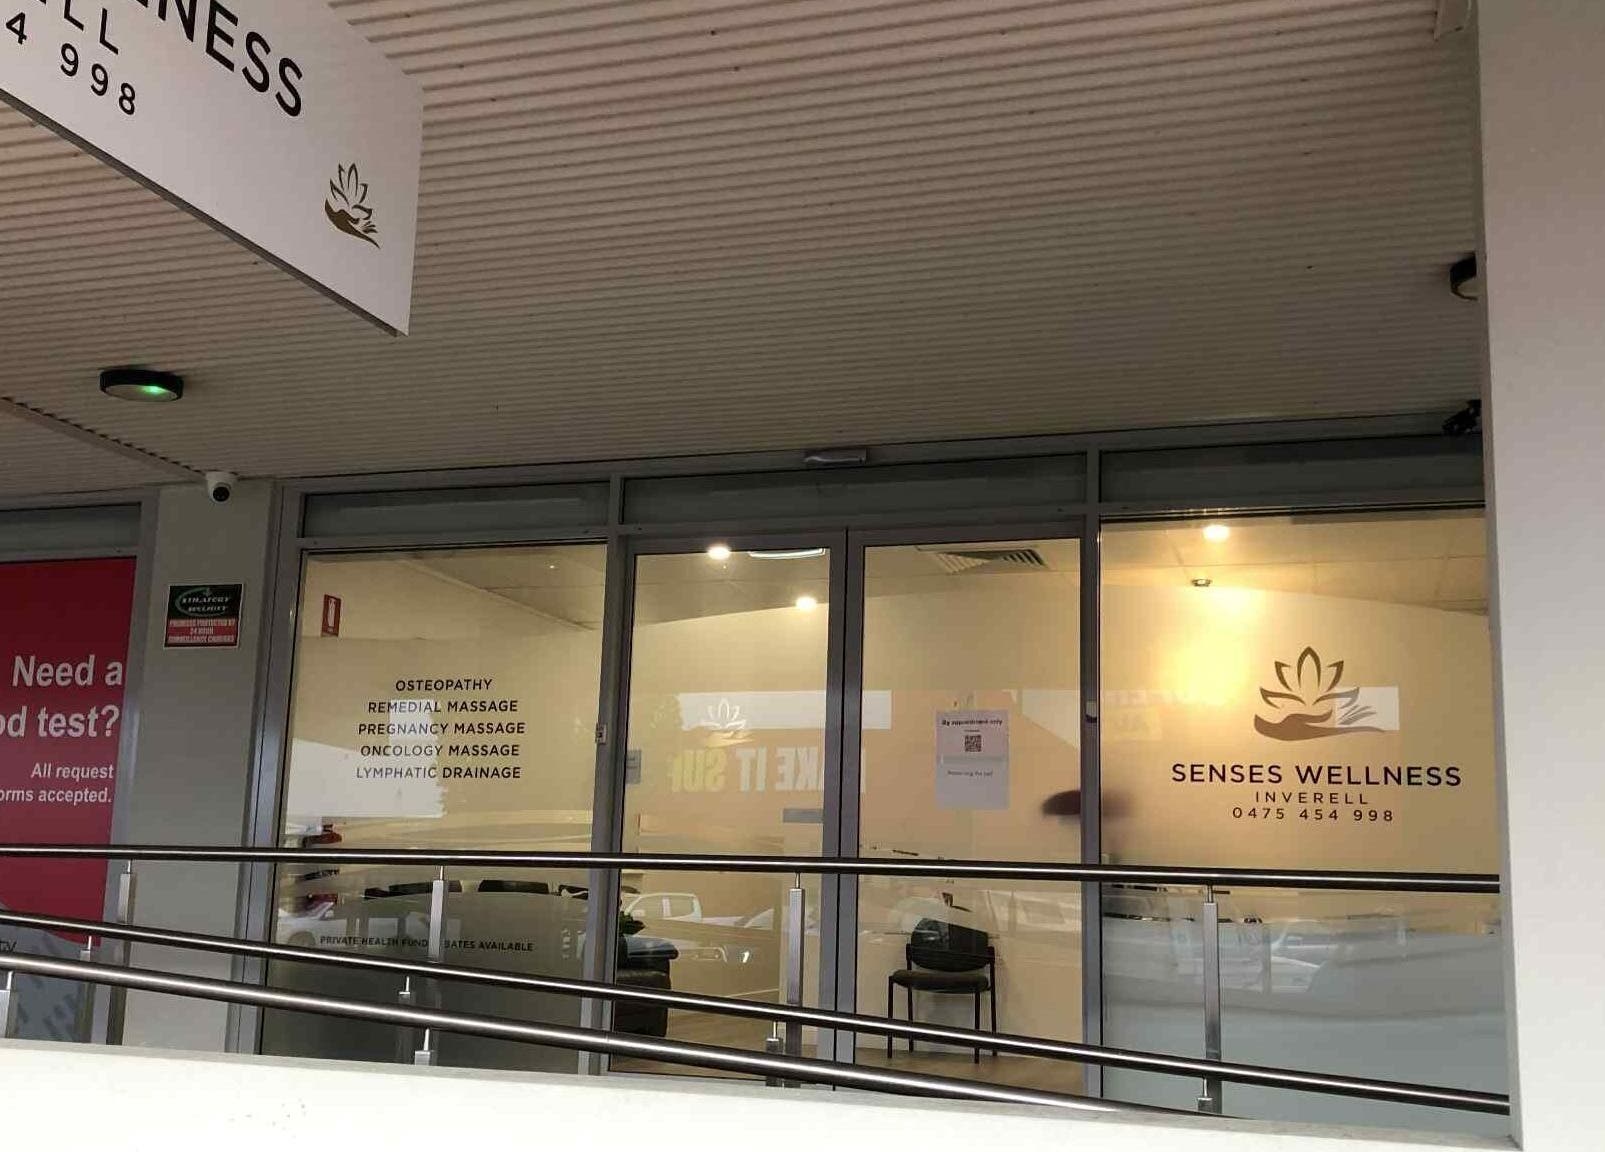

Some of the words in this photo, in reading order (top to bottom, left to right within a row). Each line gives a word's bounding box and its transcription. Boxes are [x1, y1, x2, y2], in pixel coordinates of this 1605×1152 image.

[38, 0, 119, 55] LL
[6, 12, 28, 45] 4
[60, 43, 136, 116] 998
[134, 0, 303, 117] NESS
[12, 654, 95, 687] Need
[105, 662, 123, 686] a
[395, 678, 493, 692] OSTEOPATHY
[368, 701, 441, 713] REMEDIAL
[447, 700, 519, 713] MASSAGE
[38, 704, 120, 738] test?
[358, 723, 448, 735] PREGNANCY
[454, 722, 525, 735] MASSAGE
[360, 745, 443, 757] ONCOLOGY
[448, 744, 520, 756] MASSAGE
[31, 763, 52, 778] All
[56, 763, 114, 782] request
[356, 767, 437, 779] LYMPHATIC
[442, 766, 521, 779] DRAINAGE
[1172, 763, 1283, 784] SENSES
[1295, 766, 1462, 787] WELLNESS
[38, 787, 112, 805] accepted.
[1255, 792, 1368, 805] INVERELL
[1233, 807, 1285, 820] 0475
[1299, 808, 1339, 821] 454
[1353, 809, 1394, 822] 998
[320, 935, 361, 946] PRIVATE
[362, 936, 399, 947] HEALTH
[478, 940, 534, 952] AVAILABLE
